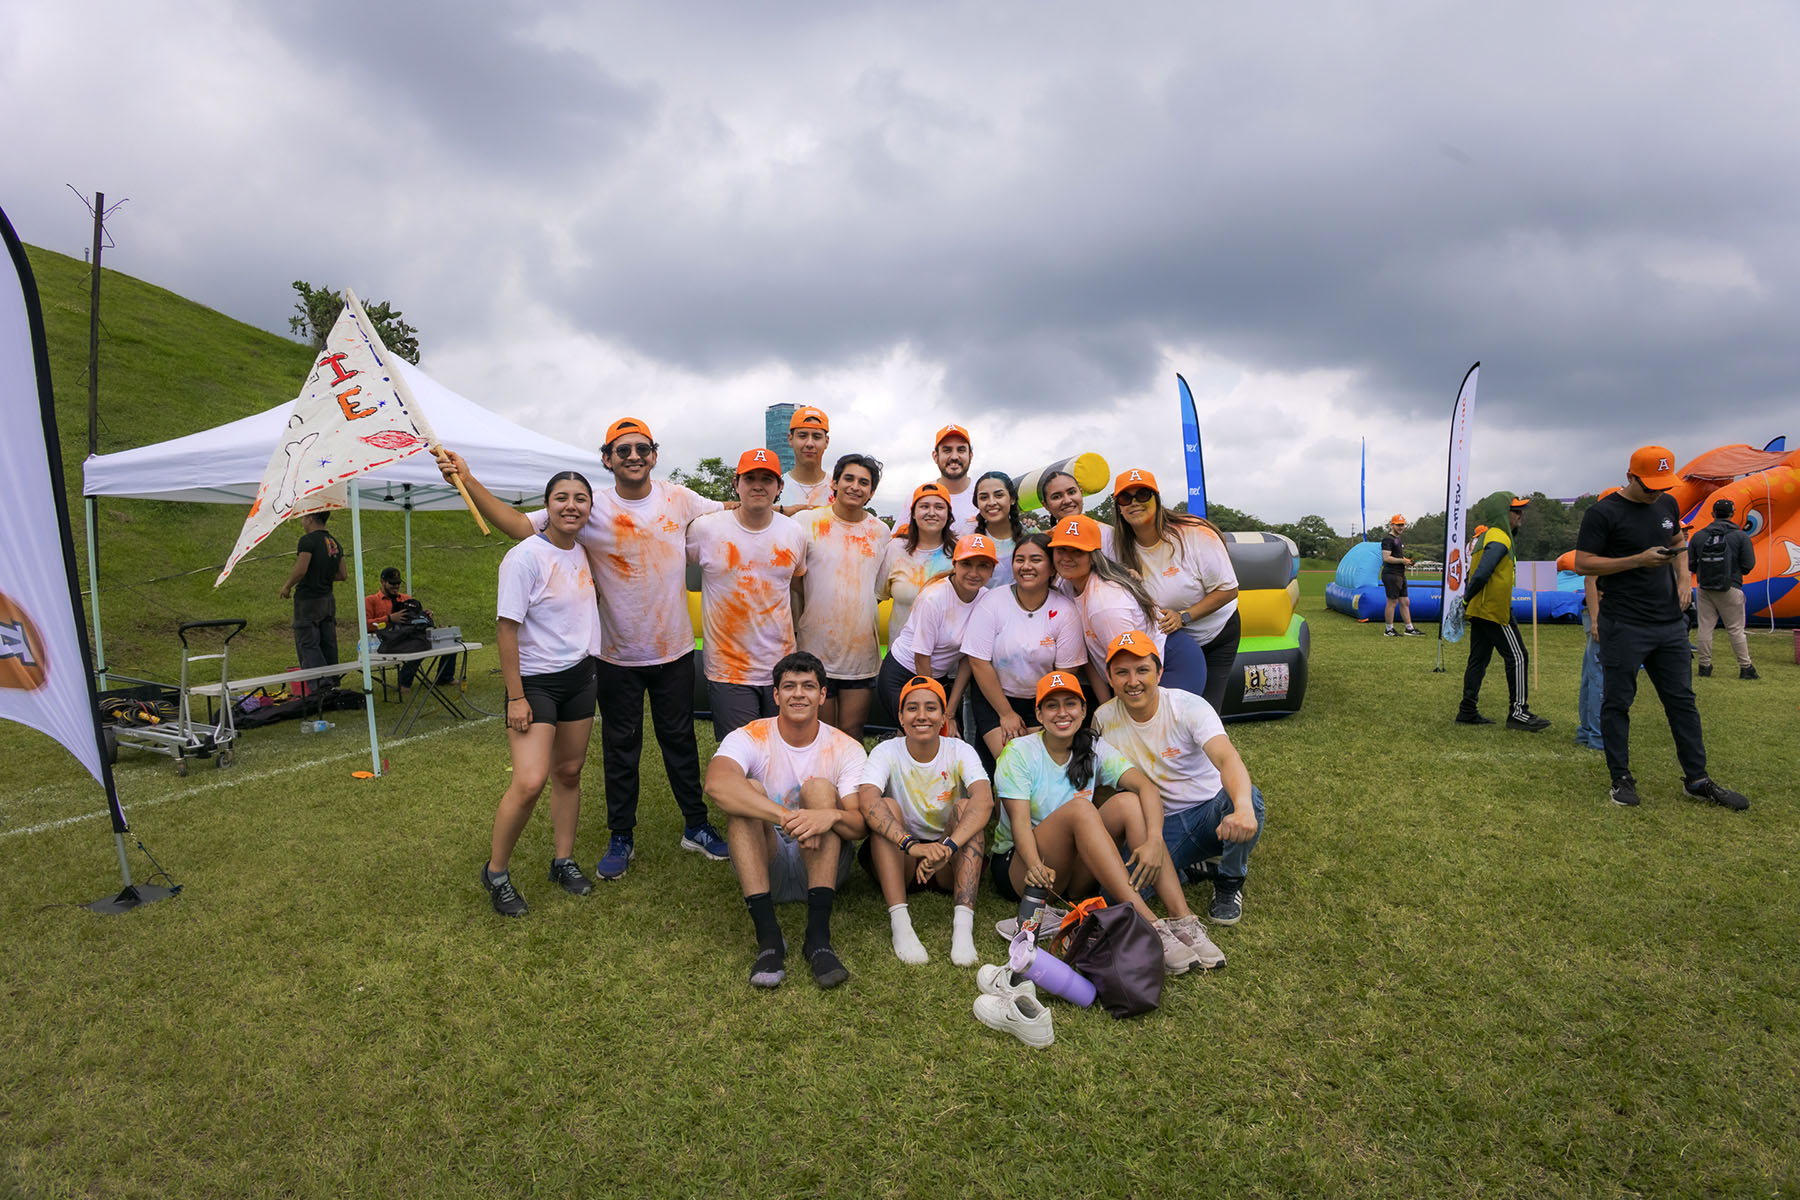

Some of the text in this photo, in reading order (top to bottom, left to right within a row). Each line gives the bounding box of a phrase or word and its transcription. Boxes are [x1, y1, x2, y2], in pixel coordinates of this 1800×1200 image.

[753, 450, 767, 462] A
[1657, 458, 1670, 471] A
[1129, 470, 1142, 481] A
[1065, 521, 1080, 536] A
[971, 536, 985, 548] A
[1118, 633, 1135, 646] A
[1050, 674, 1065, 688] A
